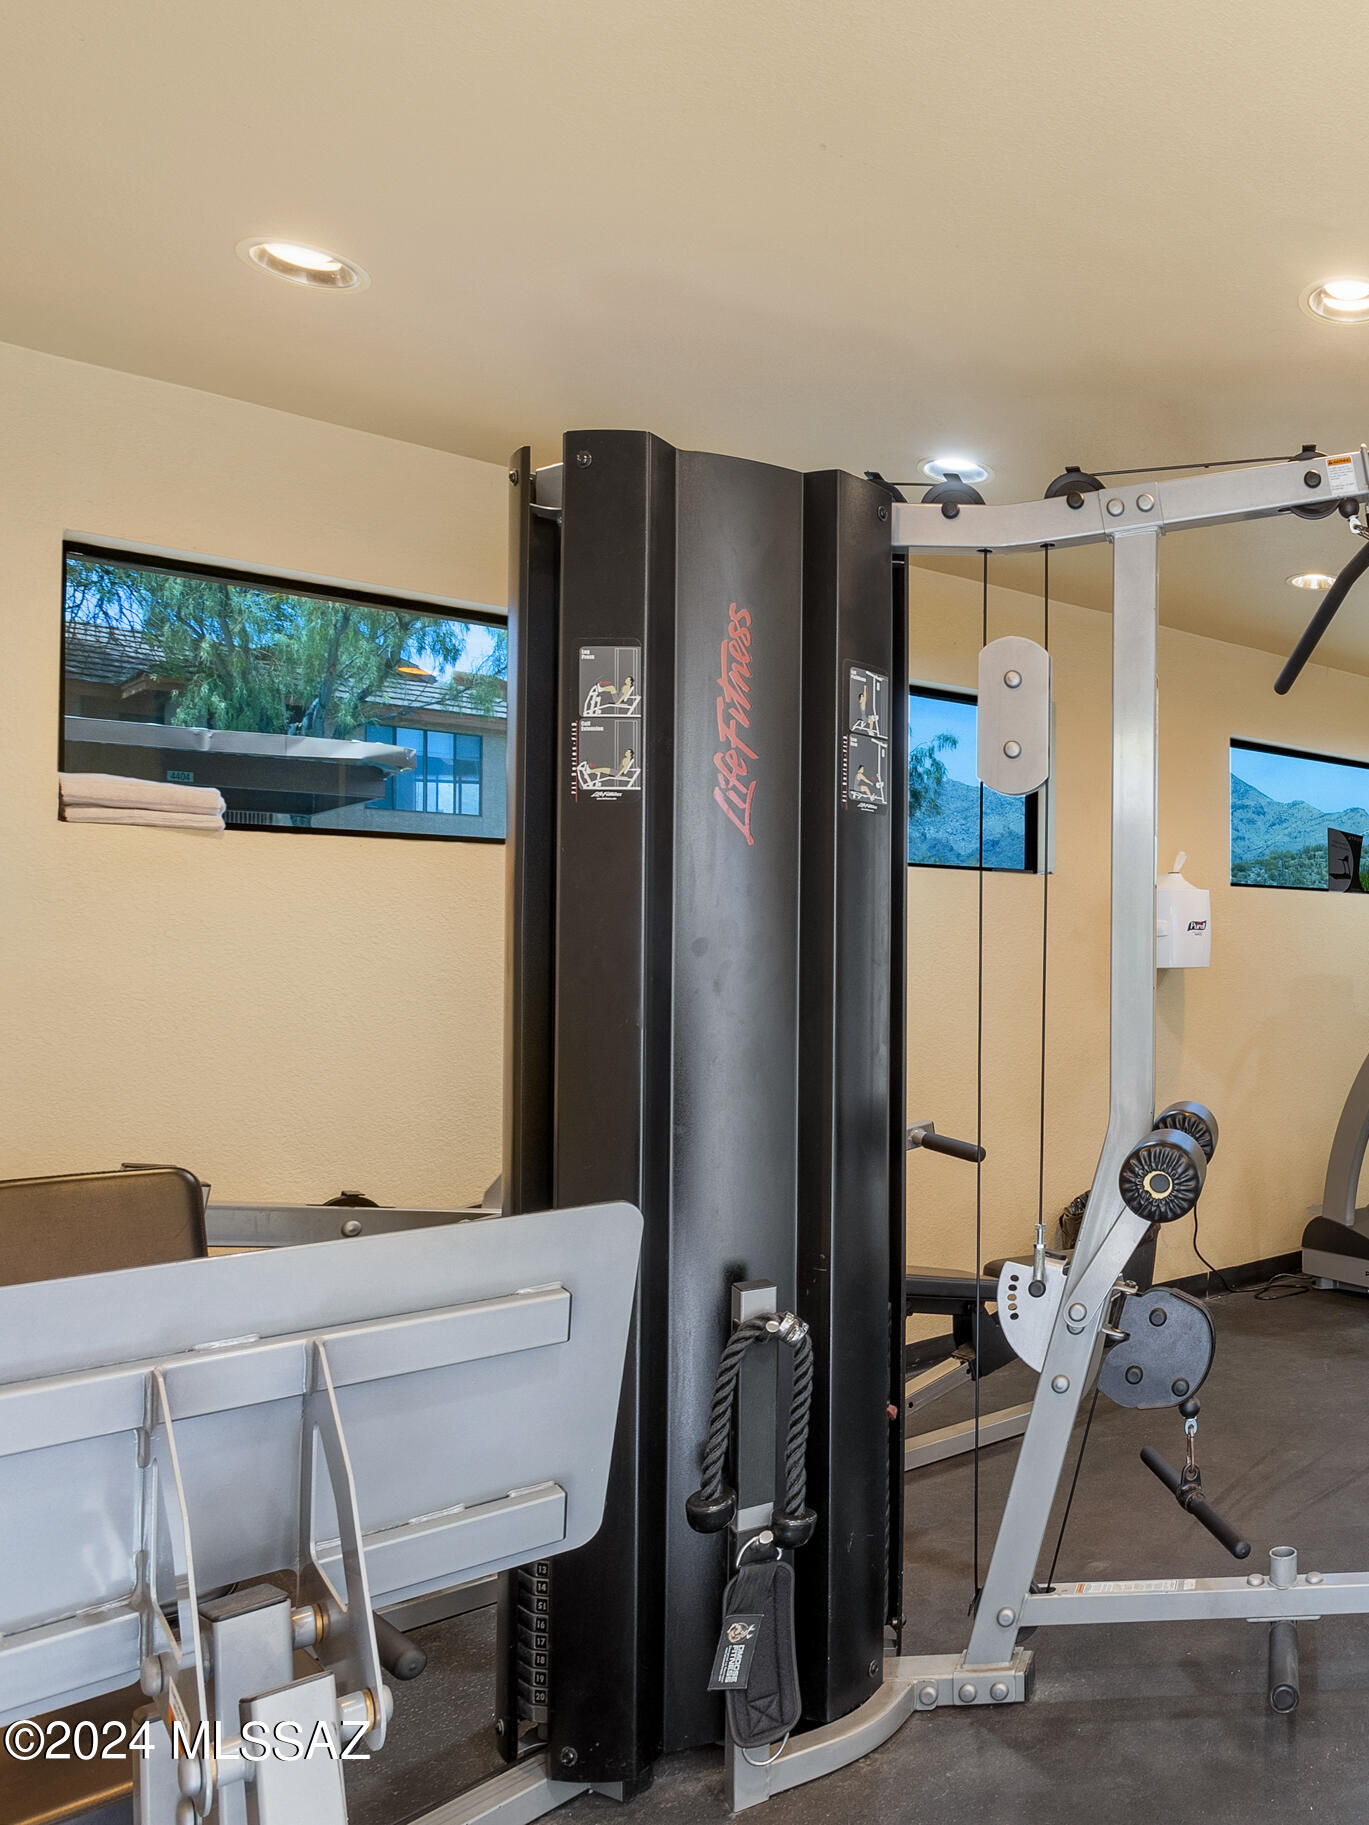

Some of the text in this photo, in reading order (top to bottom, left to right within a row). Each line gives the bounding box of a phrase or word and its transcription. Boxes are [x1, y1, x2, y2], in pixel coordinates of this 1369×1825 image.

[538, 1565, 547, 1574] 13
[537, 1582, 547, 1591] 14
[536, 1620, 545, 1629] 16
[536, 1637, 546, 1646] 17
[536, 1655, 546, 1664] 18
[536, 1674, 545, 1683] 19
[535, 1692, 545, 1701] 20
